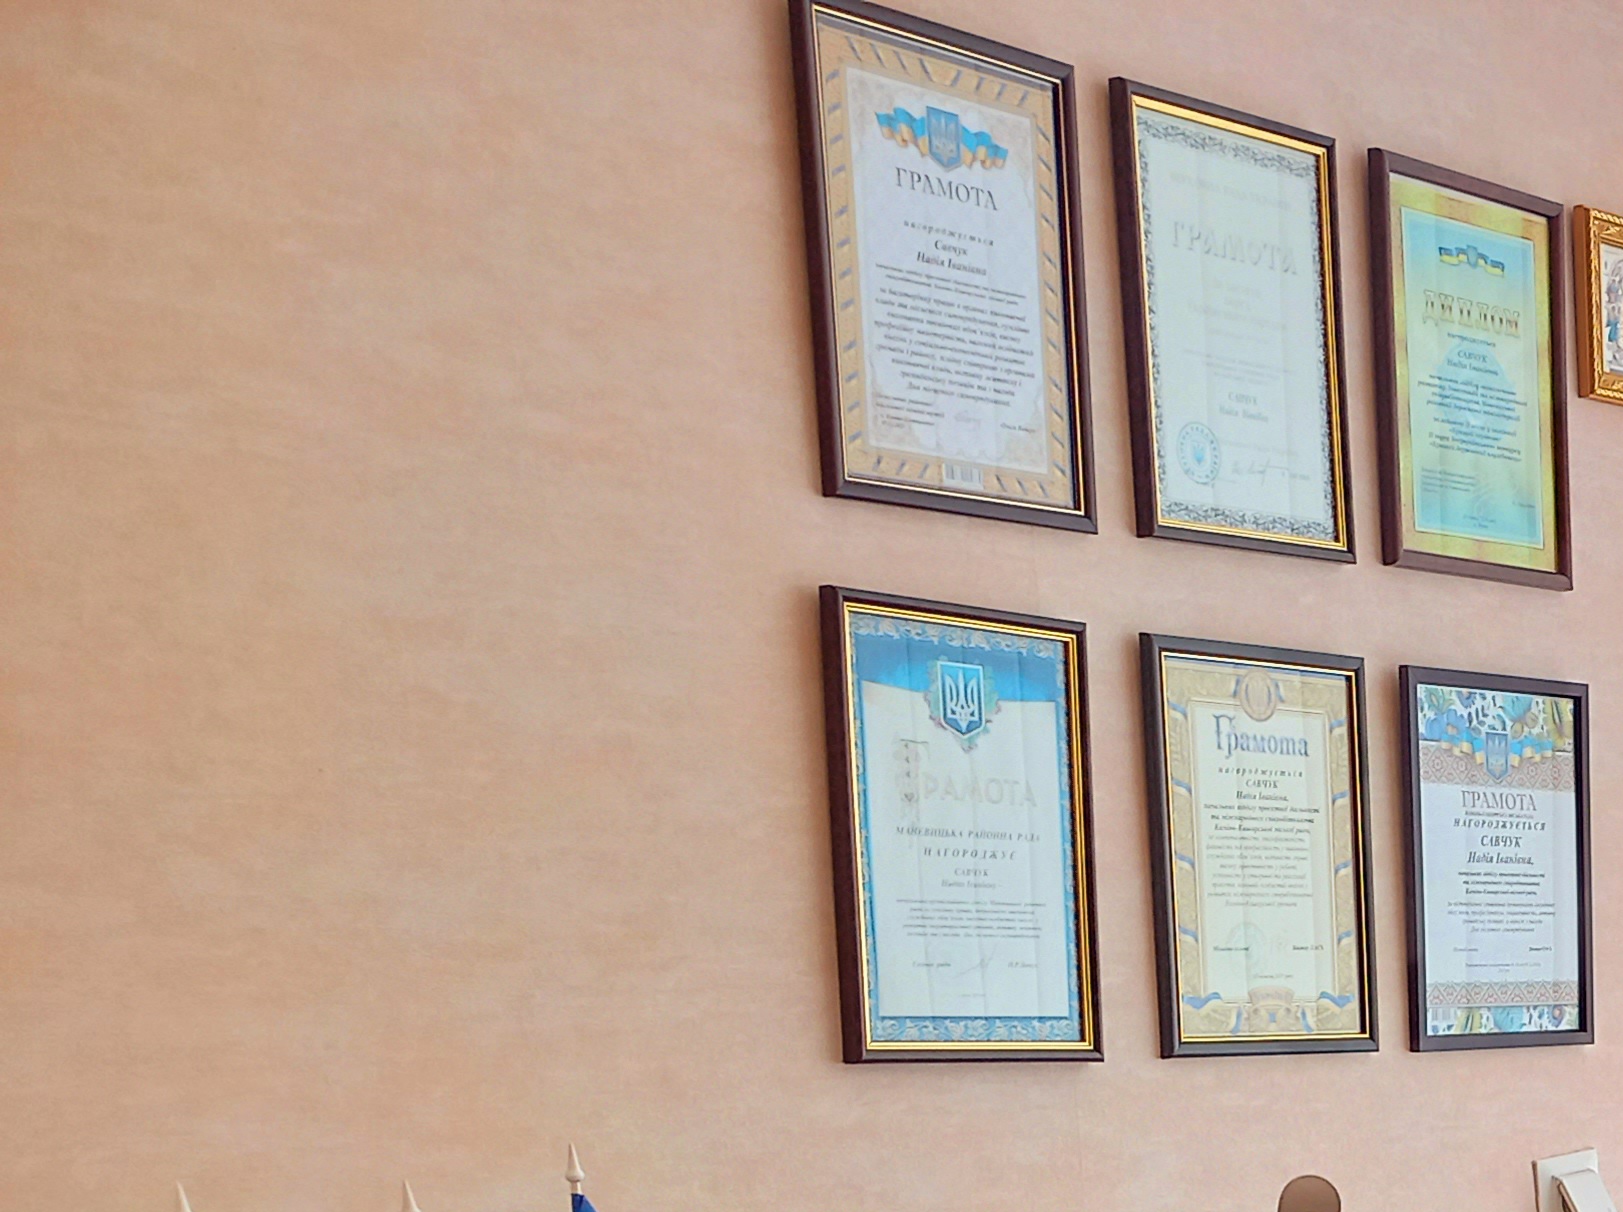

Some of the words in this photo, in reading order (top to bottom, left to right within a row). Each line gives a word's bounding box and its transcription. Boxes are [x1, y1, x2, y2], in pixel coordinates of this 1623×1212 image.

[895, 166, 998, 211] ГРАМОТА
[1212, 713, 1310, 759] Грамота
[1461, 790, 1537, 811] ГРАМОТА
[1480, 835, 1523, 848] САВЧУК
